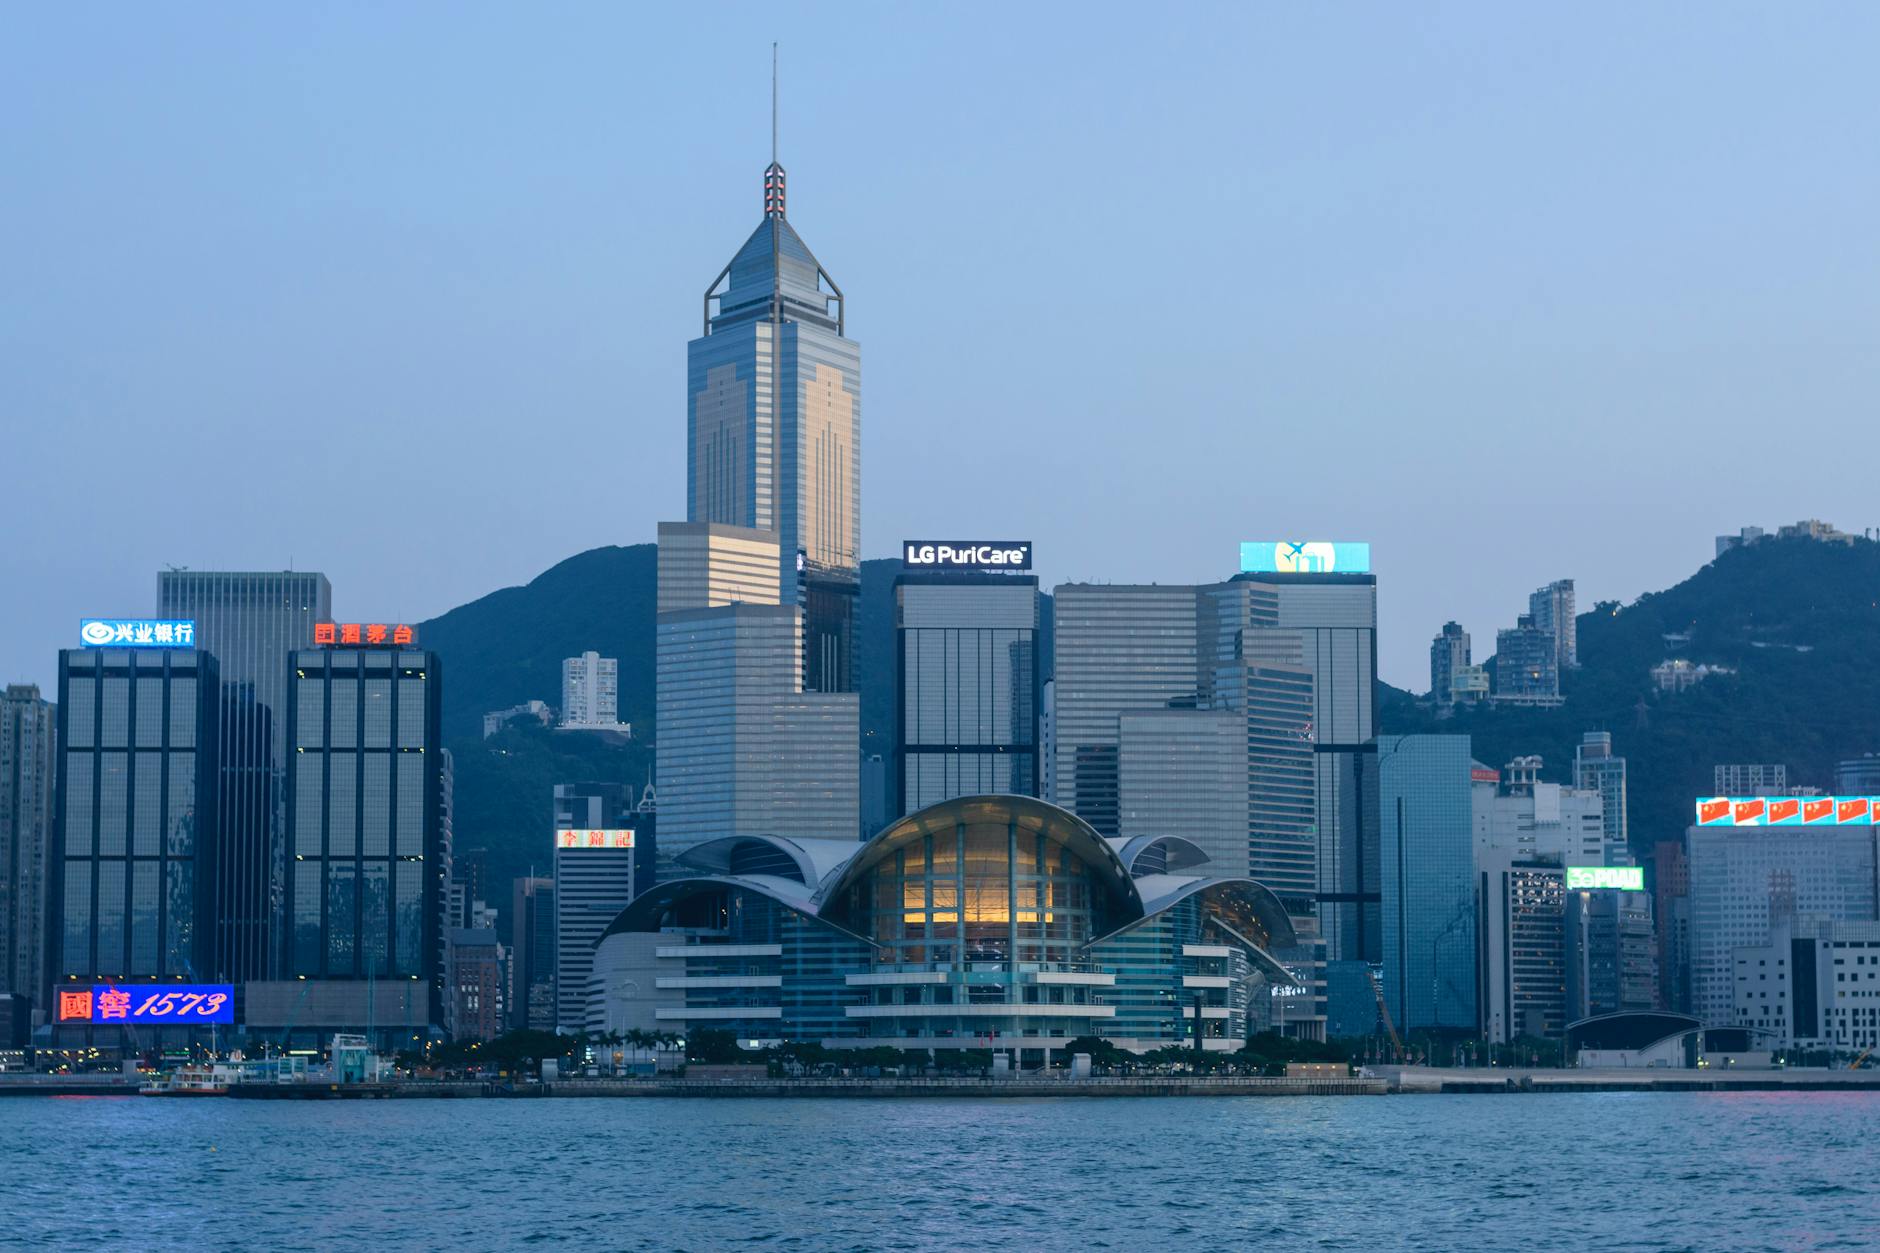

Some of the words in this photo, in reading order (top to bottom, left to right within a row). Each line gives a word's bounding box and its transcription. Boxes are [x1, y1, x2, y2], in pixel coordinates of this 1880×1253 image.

[908, 546, 935, 564] LG
[114, 623, 194, 643] 兴业银行
[60, 989, 131, 1020] 國窖
[133, 992, 228, 1016] 1573
